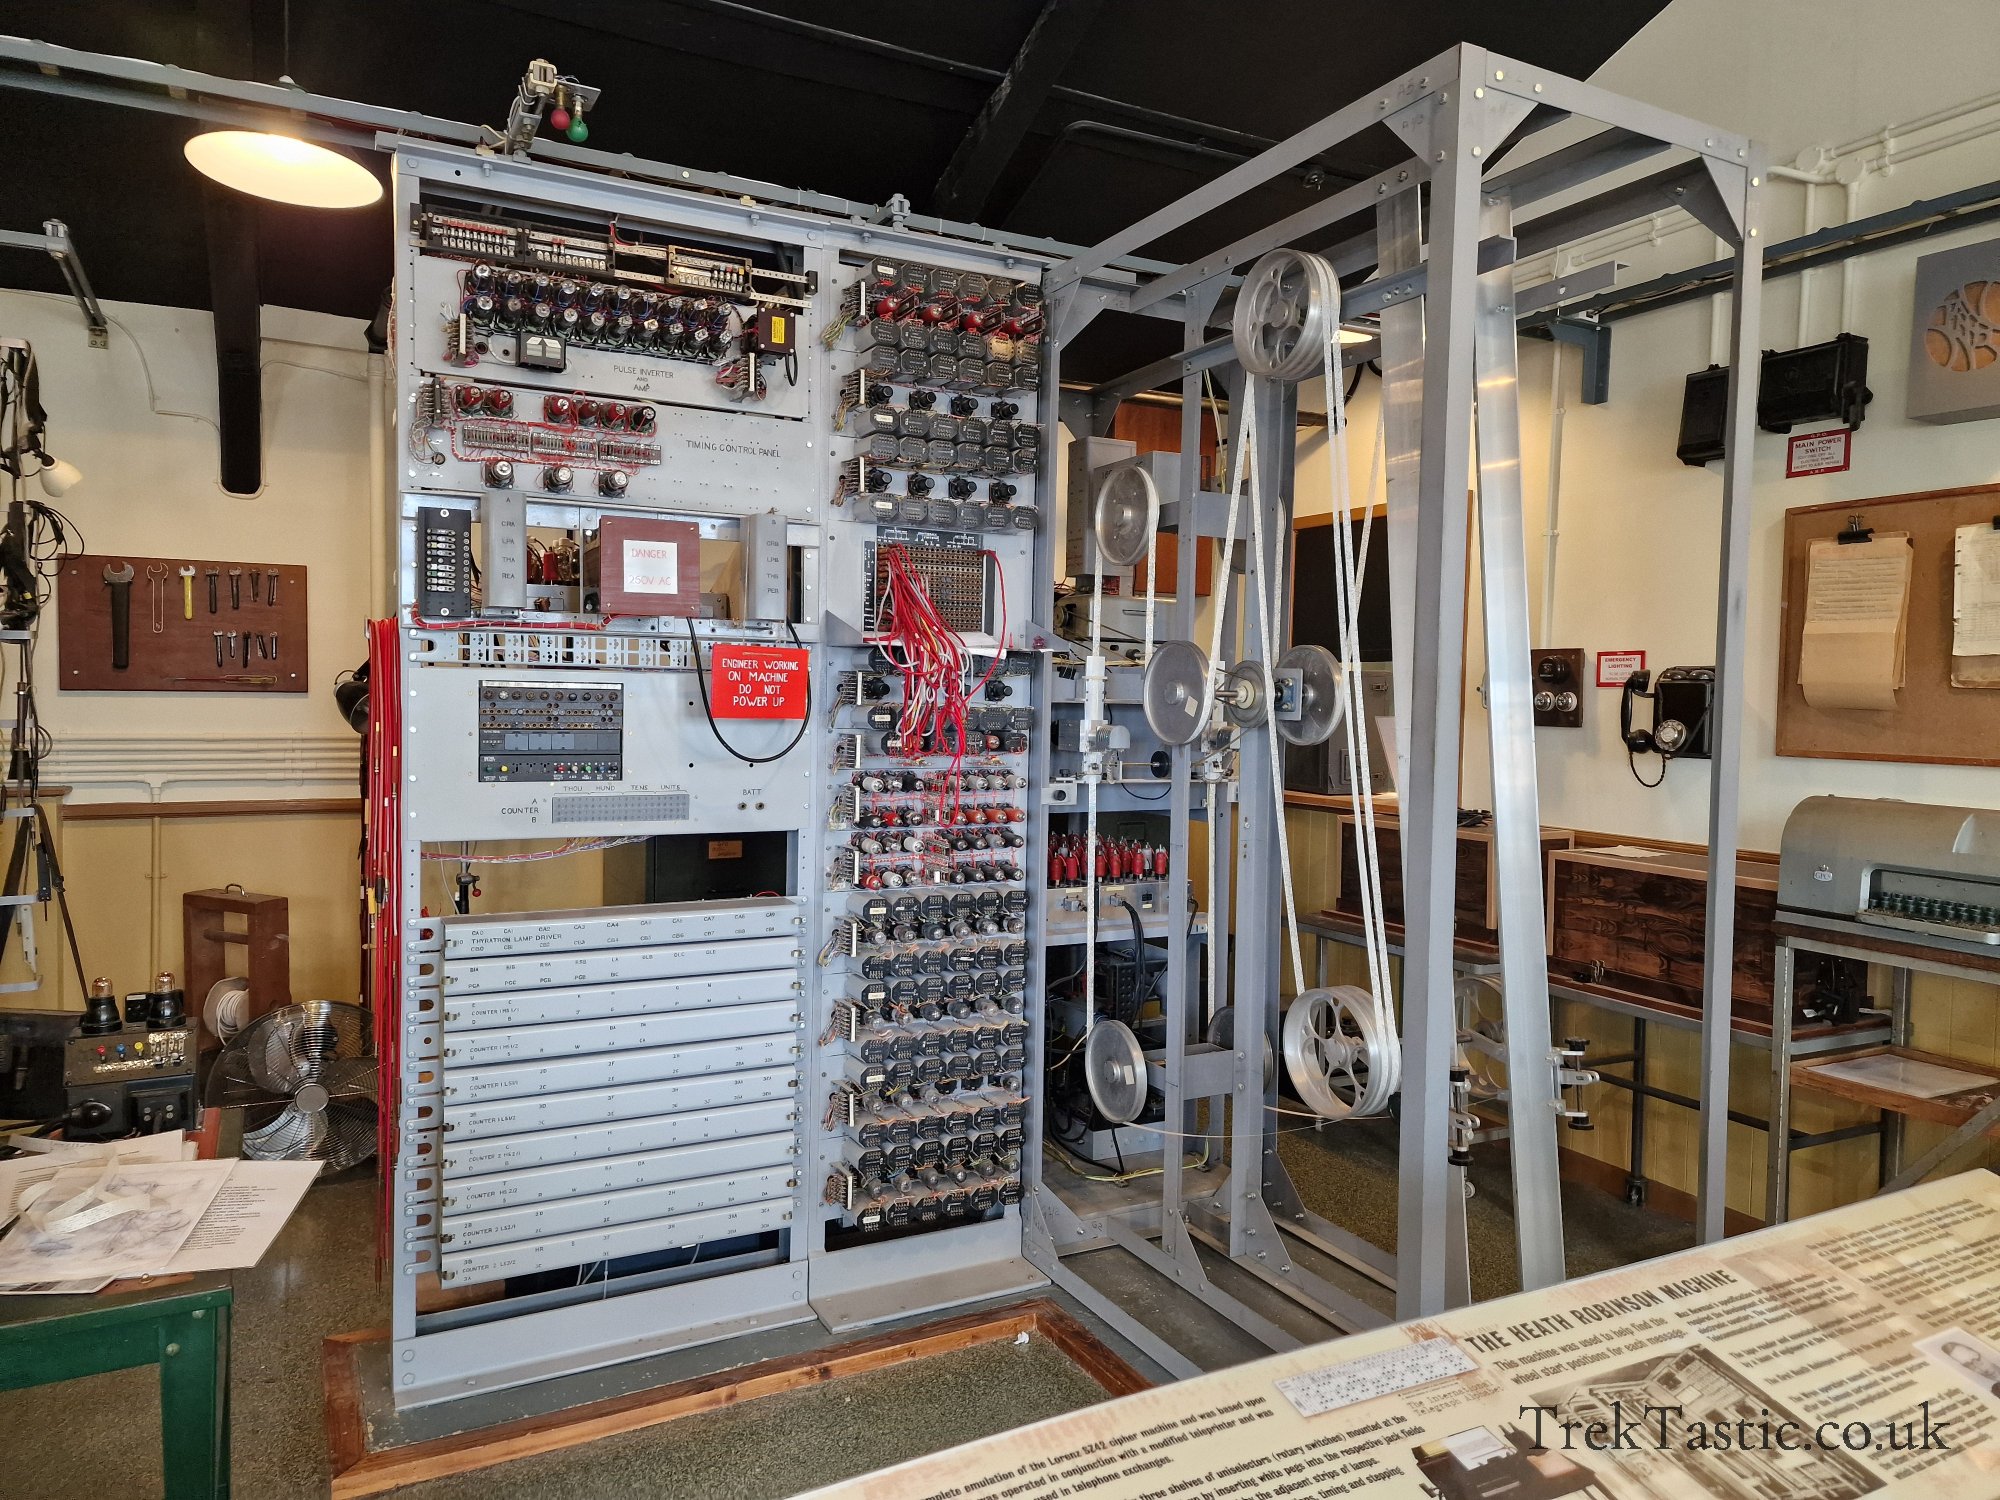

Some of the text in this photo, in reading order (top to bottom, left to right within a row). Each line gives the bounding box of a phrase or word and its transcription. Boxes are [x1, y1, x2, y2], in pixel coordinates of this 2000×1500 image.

[614, 365, 673, 378] PULSE INVERTER
[686, 440, 780, 458] TIMING CONTROL PANEL
[1805, 446, 1831, 454] SWITCH
[632, 549, 667, 558] DANGER
[629, 575, 671, 585] 250V AC
[722, 658, 798, 670] ENGINEER WORKING
[728, 671, 788, 682] ON MACHINE
[739, 684, 781, 694] DO NOT
[733, 696, 784, 706] POWER UP
[501, 807, 539, 815] COUNTER
[469, 1118, 496, 1126] COUNTER
[466, 1191, 495, 1200] COUNTER
[463, 1228, 492, 1238] COUNTER
[462, 1264, 489, 1273] COUNTER
[1464, 1330, 1512, 1353] THE
[1507, 1314, 1572, 1343] HEATH
[1570, 1290, 1664, 1326] ROBINSON
[1658, 1269, 1738, 1300] MACHINE
[1492, 1316, 1668, 1372] This machine was used to help find the
[1511, 1368, 1542, 1385] wheel
[1542, 1362, 1566, 1378] start
[1568, 1350, 1608, 1370] positions
[1606, 1346, 1624, 1358] for
[1623, 1339, 1647, 1353] each
[1407, 1400, 1425, 1409] The
[965, 1395, 1266, 1493] emulation of the Lorenz SZ42 cipher machine and was based upon
[1001, 1475, 1046, 1498] operated
[1048, 1472, 1059, 1481] in
[1061, 1455, 1117, 1478] conjunction
[1118, 1448, 1139, 1461] with
[1149, 1433, 1189, 1451] modified
[1189, 1420, 1236, 1439] teleprinter
[1238, 1414, 1256, 1425] and
[1256, 1408, 1274, 1419] was
[1139, 1414, 1407, 1500] three shelves of uniselectors (rotary switches) mounted at the
[1215, 1477, 1259, 1497] inserting
[1258, 1469, 1283, 1484] white
[1284, 1463, 1305, 1476] pegs
[1306, 1456, 1324, 1468] into
[1323, 1451, 1340, 1461] the
[1340, 1439, 1384, 1457] respective
[1384, 1432, 1402, 1446] jack
[1400, 1424, 1426, 1439] fields
[1060, 1486, 1071, 1495] in
[1073, 1472, 1120, 1494] telephone
[1122, 1455, 1174, 1477] exchanges.
[1256, 1490, 1273, 1500] the
[1274, 1476, 1313, 1496] adjacent
[1312, 1467, 1340, 1484] strips
[1340, 1463, 1350, 1474] of
[1350, 1456, 1380, 1471] lamps.
[1318, 1483, 1346, 1499] timing
[1348, 1477, 1366, 1489] and
[1366, 1466, 1405, 1484] stepping
